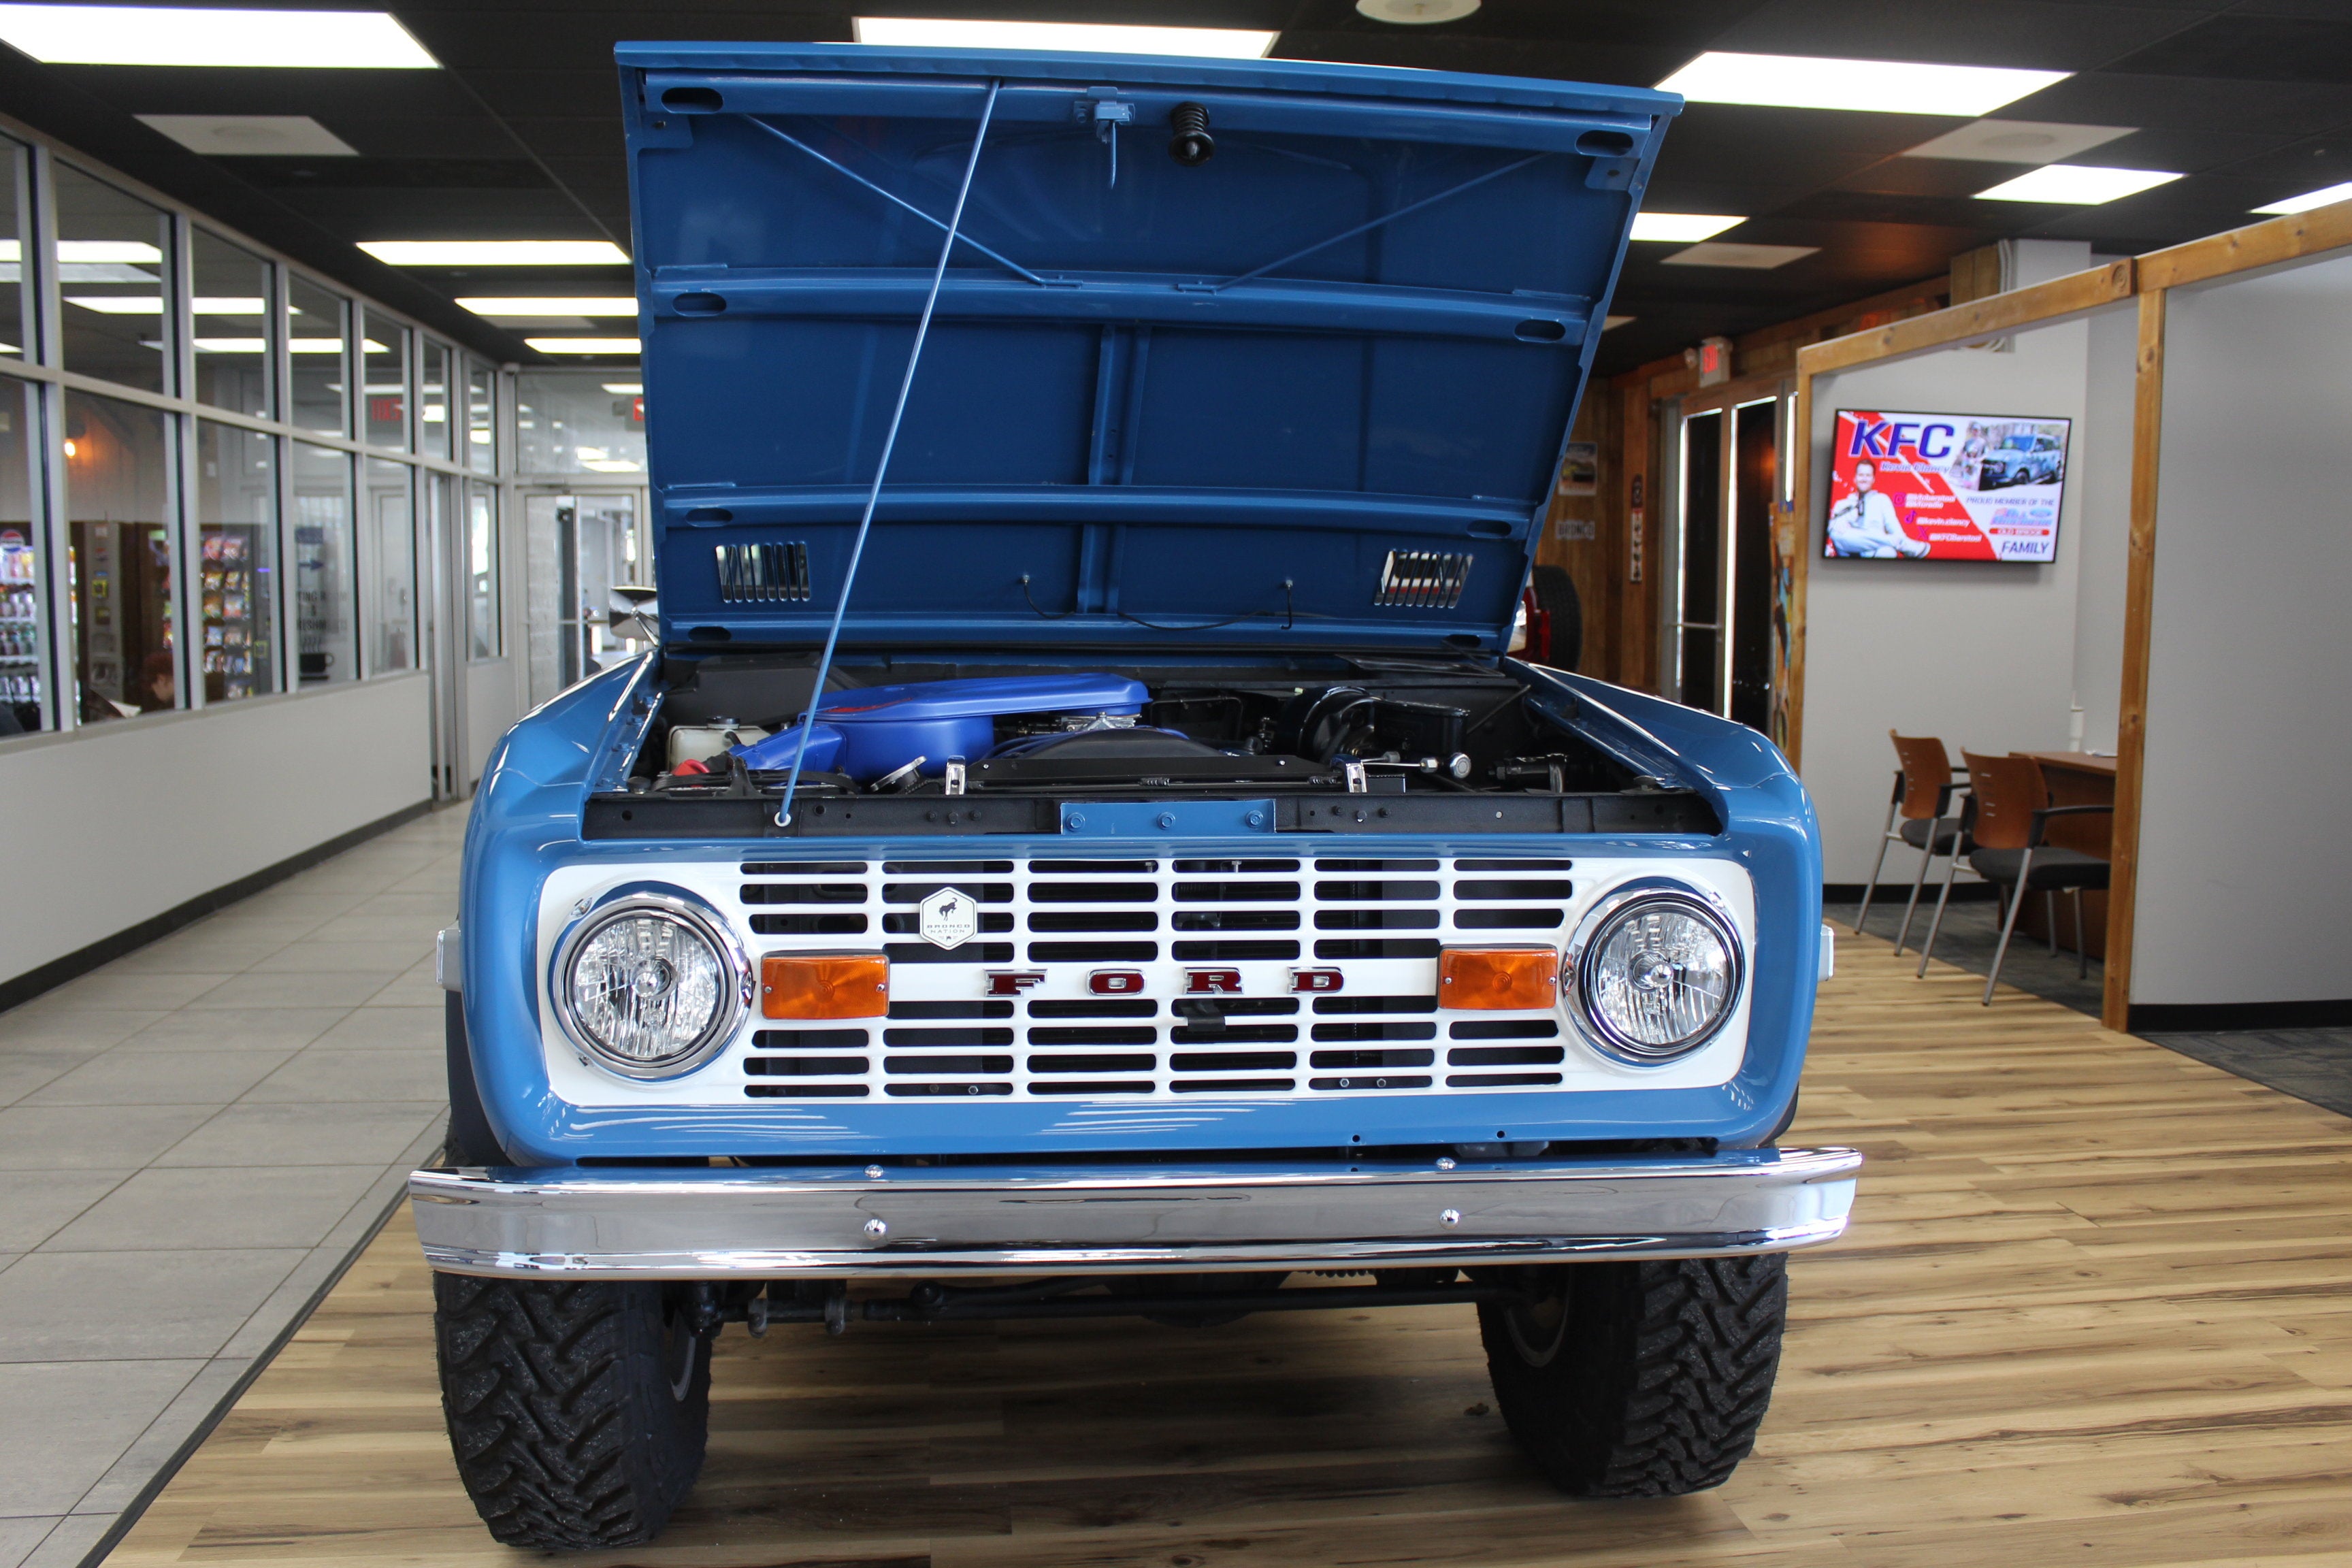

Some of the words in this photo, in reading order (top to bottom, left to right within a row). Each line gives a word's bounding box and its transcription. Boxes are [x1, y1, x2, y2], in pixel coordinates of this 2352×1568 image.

[1848, 419, 1955, 459] KFC
[2002, 540, 2050, 554] FAMILY
[983, 965, 1346, 998] FORD
